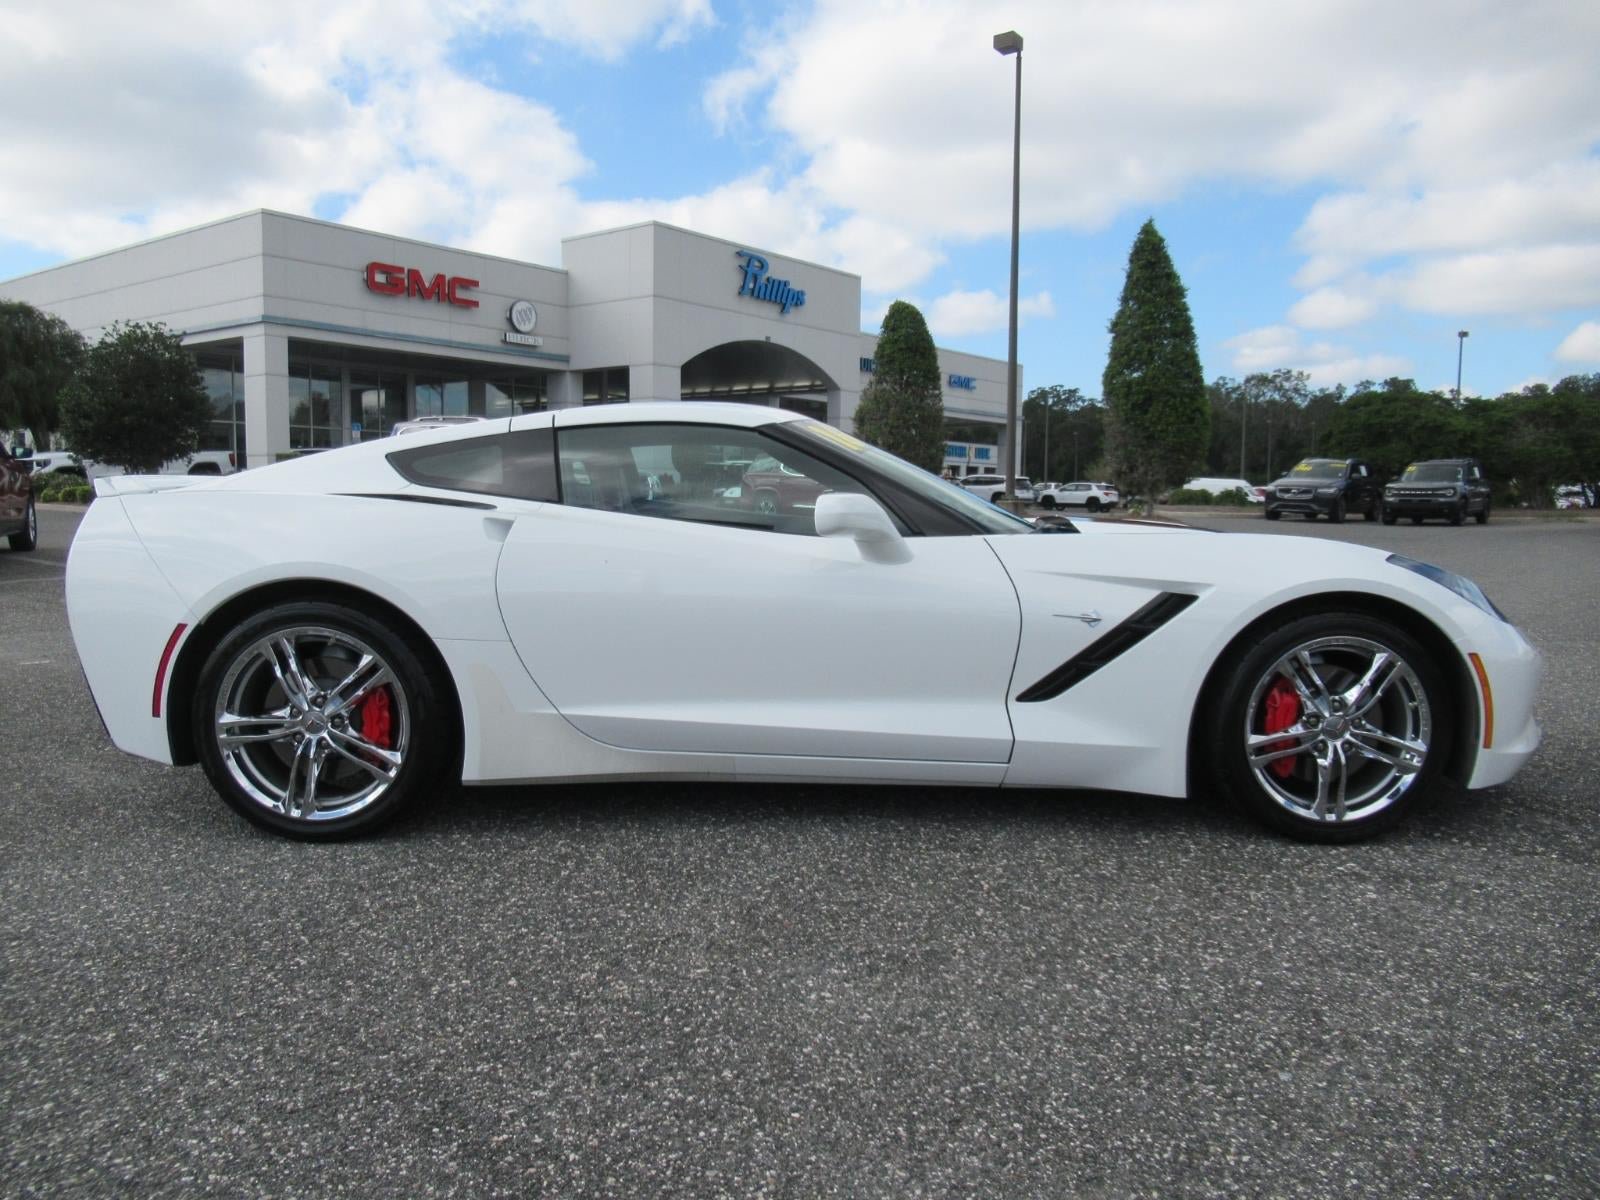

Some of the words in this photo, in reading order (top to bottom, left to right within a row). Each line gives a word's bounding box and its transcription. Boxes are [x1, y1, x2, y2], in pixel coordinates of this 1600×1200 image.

[367, 262, 480, 308] GMC
[736, 250, 806, 314] Phillips
[949, 375, 977, 390] GMC
